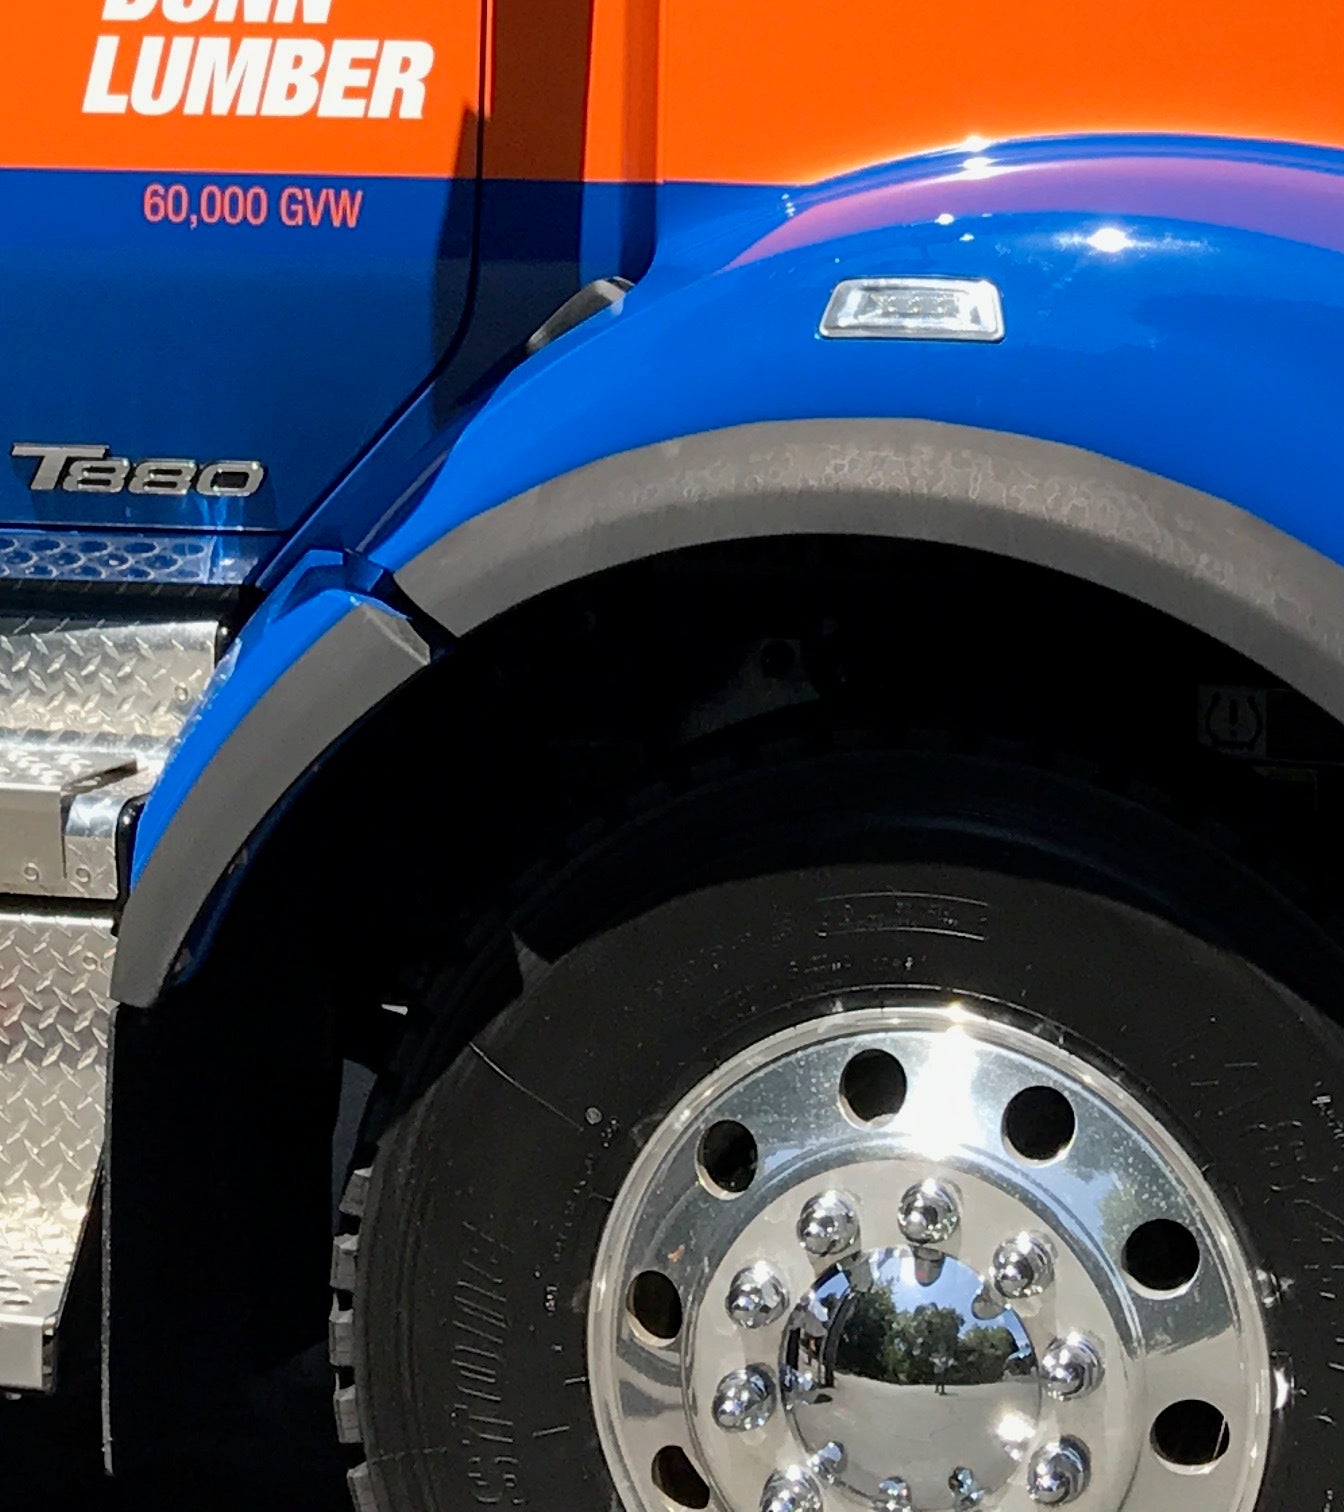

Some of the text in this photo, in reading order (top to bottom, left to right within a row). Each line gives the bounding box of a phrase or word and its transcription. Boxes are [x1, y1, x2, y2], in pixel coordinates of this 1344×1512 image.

[81, 35, 435, 120] LUMBER
[142, 183, 364, 230] 60,000 GVW
[11, 442, 265, 497] T880
